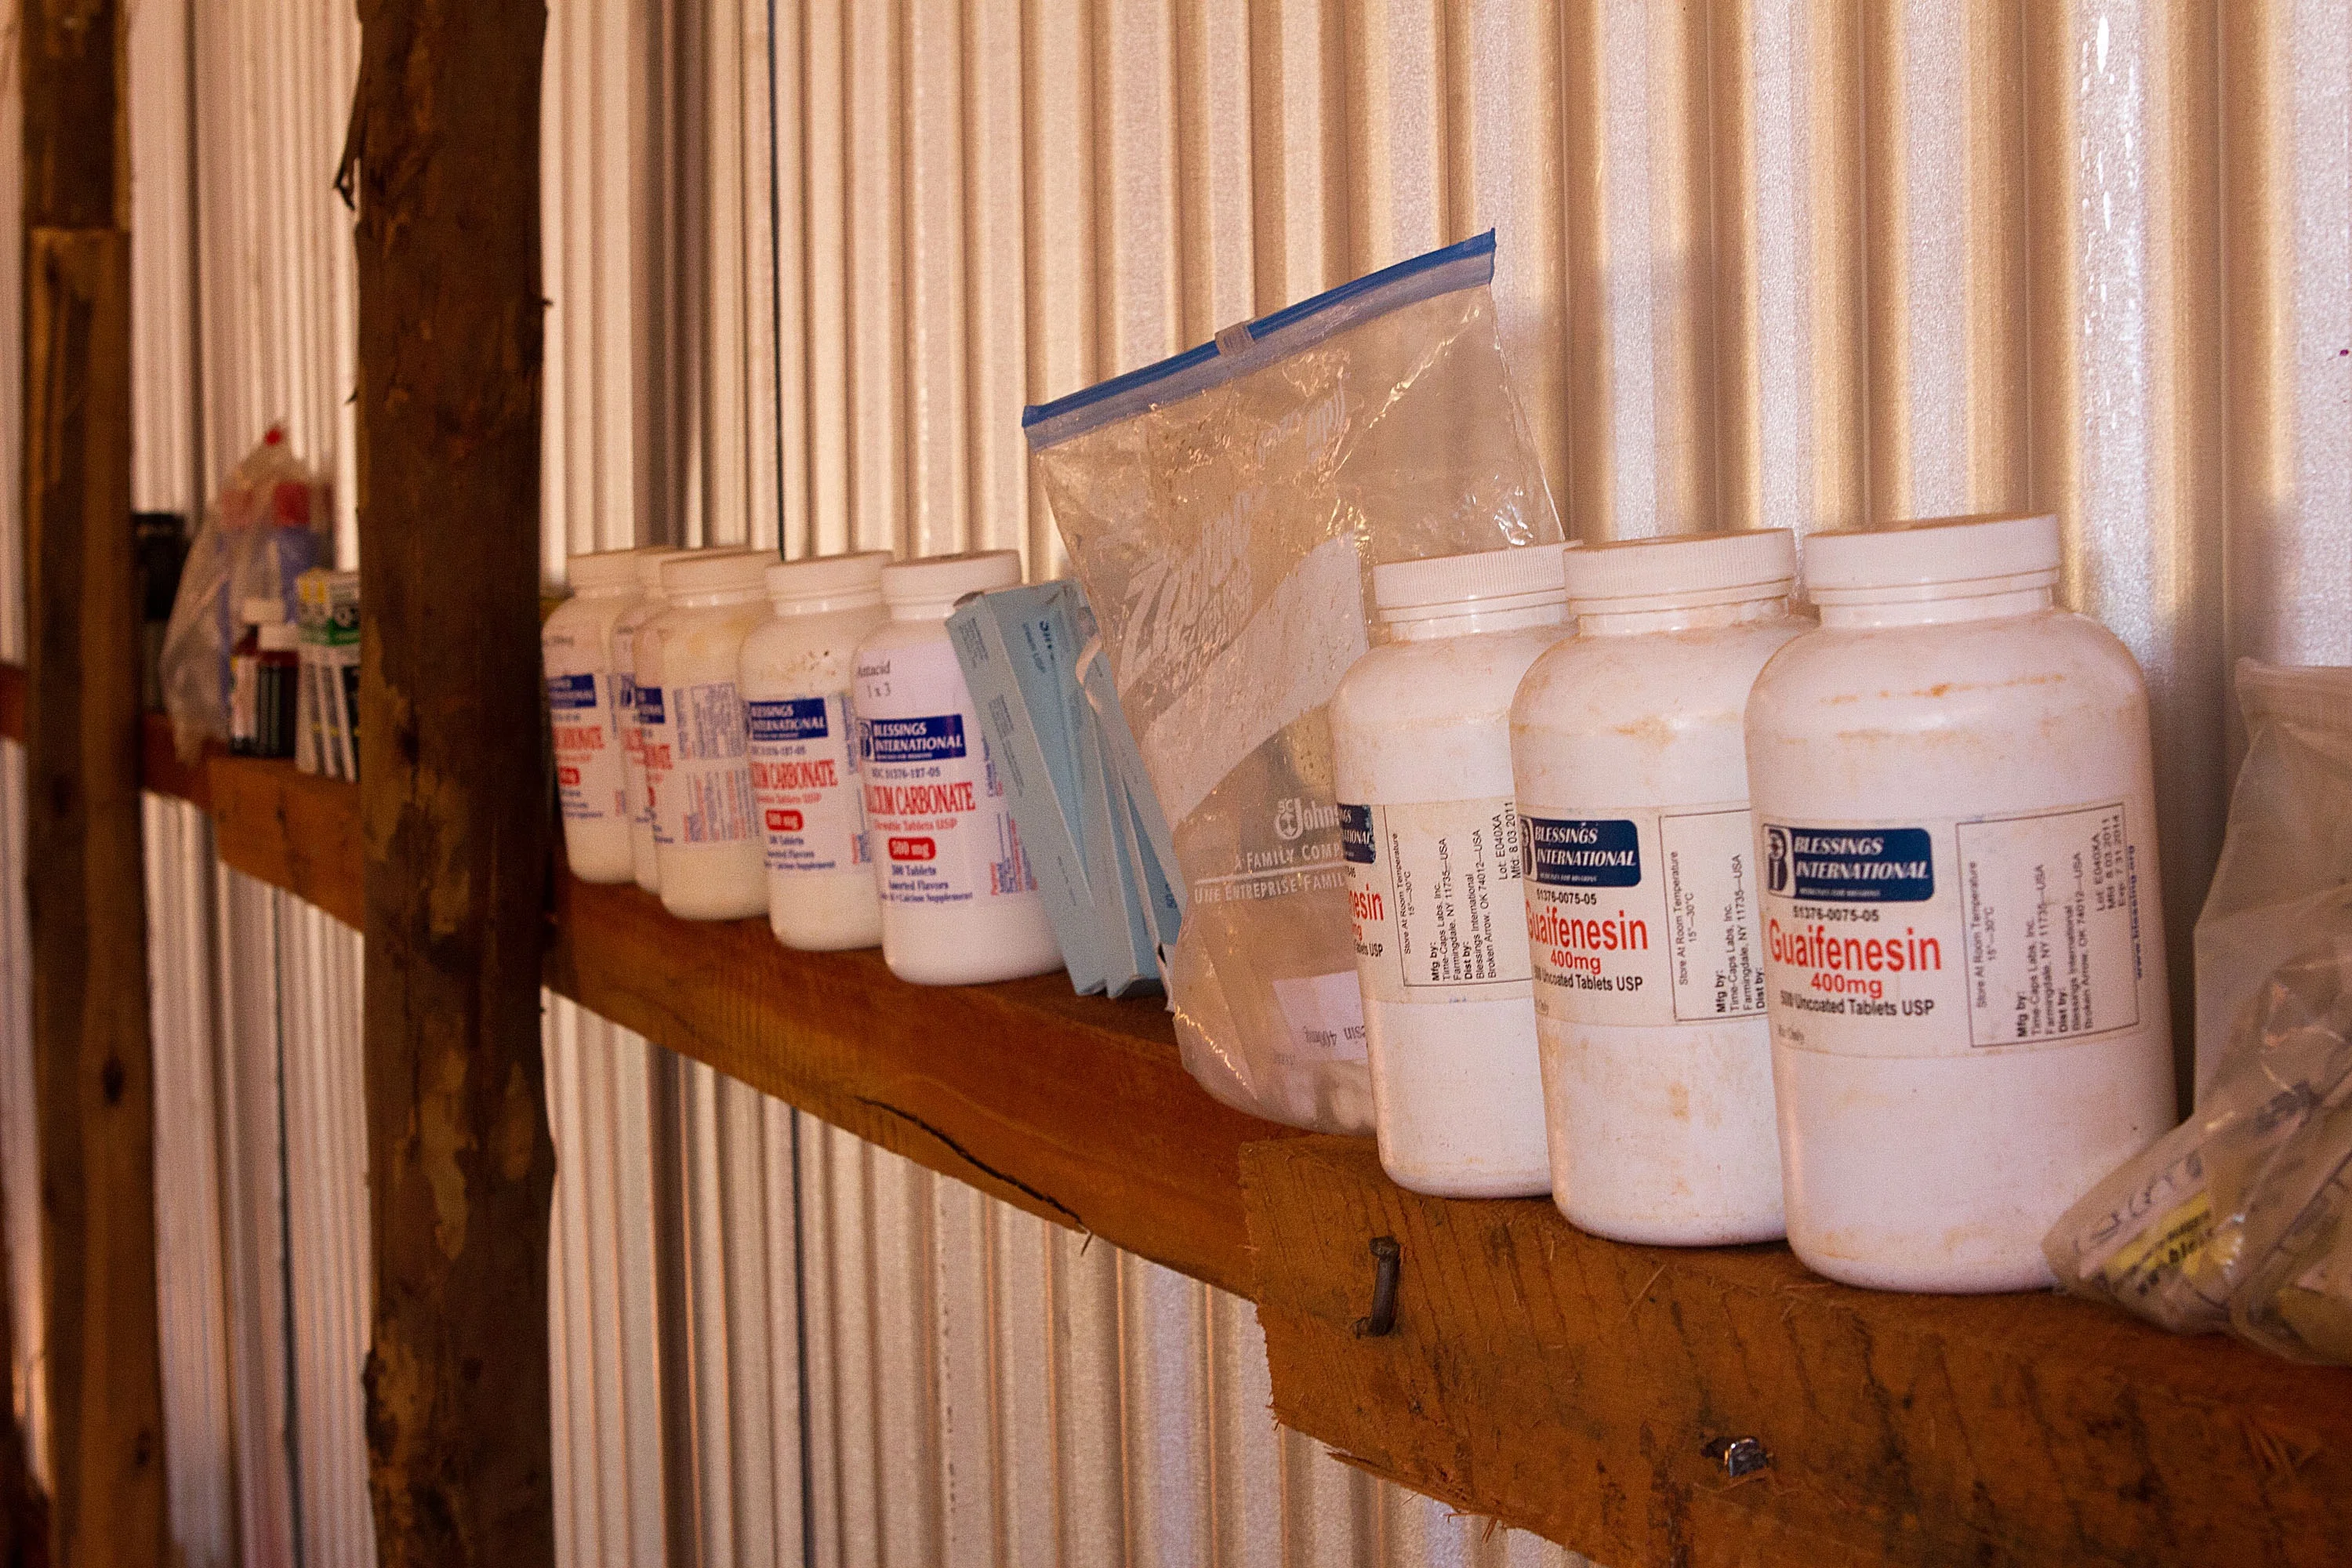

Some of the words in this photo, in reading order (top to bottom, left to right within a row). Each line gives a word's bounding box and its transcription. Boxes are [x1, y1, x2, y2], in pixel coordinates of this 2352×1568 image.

[895, 781, 976, 816] CARBONATE
[1492, 814, 1505, 858] E040XA
[1534, 826, 1599, 844] BLESSINGS
[1794, 836, 1885, 855] BLESSINGS
[1247, 847, 1294, 869] FAMILY
[1301, 843, 1341, 861] COMP
[1392, 833, 1404, 888] Temperature
[1537, 848, 1637, 867] INTERNATIONAL
[1671, 851, 1682, 913] Temperature
[1795, 861, 1930, 880] INTERNATIONAL
[1225, 878, 1299, 902] ENTREPRISE
[1303, 873, 1346, 892] FAMIL
[1399, 891, 1407, 917] Room
[1445, 902, 1455, 917] NY
[1465, 873, 1479, 931] International
[1480, 894, 1490, 909] OK
[1401, 919, 1410, 930] At
[1675, 915, 1685, 945] Room
[1737, 924, 1748, 941] NY
[1369, 943, 1384, 957] USP
[1430, 942, 1439, 959] by:
[1439, 930, 1450, 981] Time-Caps
[1462, 941, 1472, 958] by:
[1474, 934, 1485, 979] Blessings
[1769, 917, 1942, 972] Guaifenesin
[1431, 961, 1441, 981] Mfg
[1465, 960, 1473, 980] Dist
[1487, 943, 1497, 978] Broken
[1551, 949, 1602, 976] 400mg
[1575, 974, 1613, 992] Tablets
[1617, 976, 1643, 992] USP
[1679, 960, 1689, 986] Store
[1715, 970, 1726, 988] by:
[1727, 956, 1739, 1012] Time-Caps
[1755, 987, 1766, 1009] Dist
[1810, 972, 1883, 1000] 400mg
[1716, 991, 1728, 1013] Mfg
[1795, 993, 1845, 1014] Uncoated
[1847, 998, 1897, 1016] Tablets
[1901, 998, 1935, 1016] USP
[2016, 1012, 2029, 1037] Mfg
